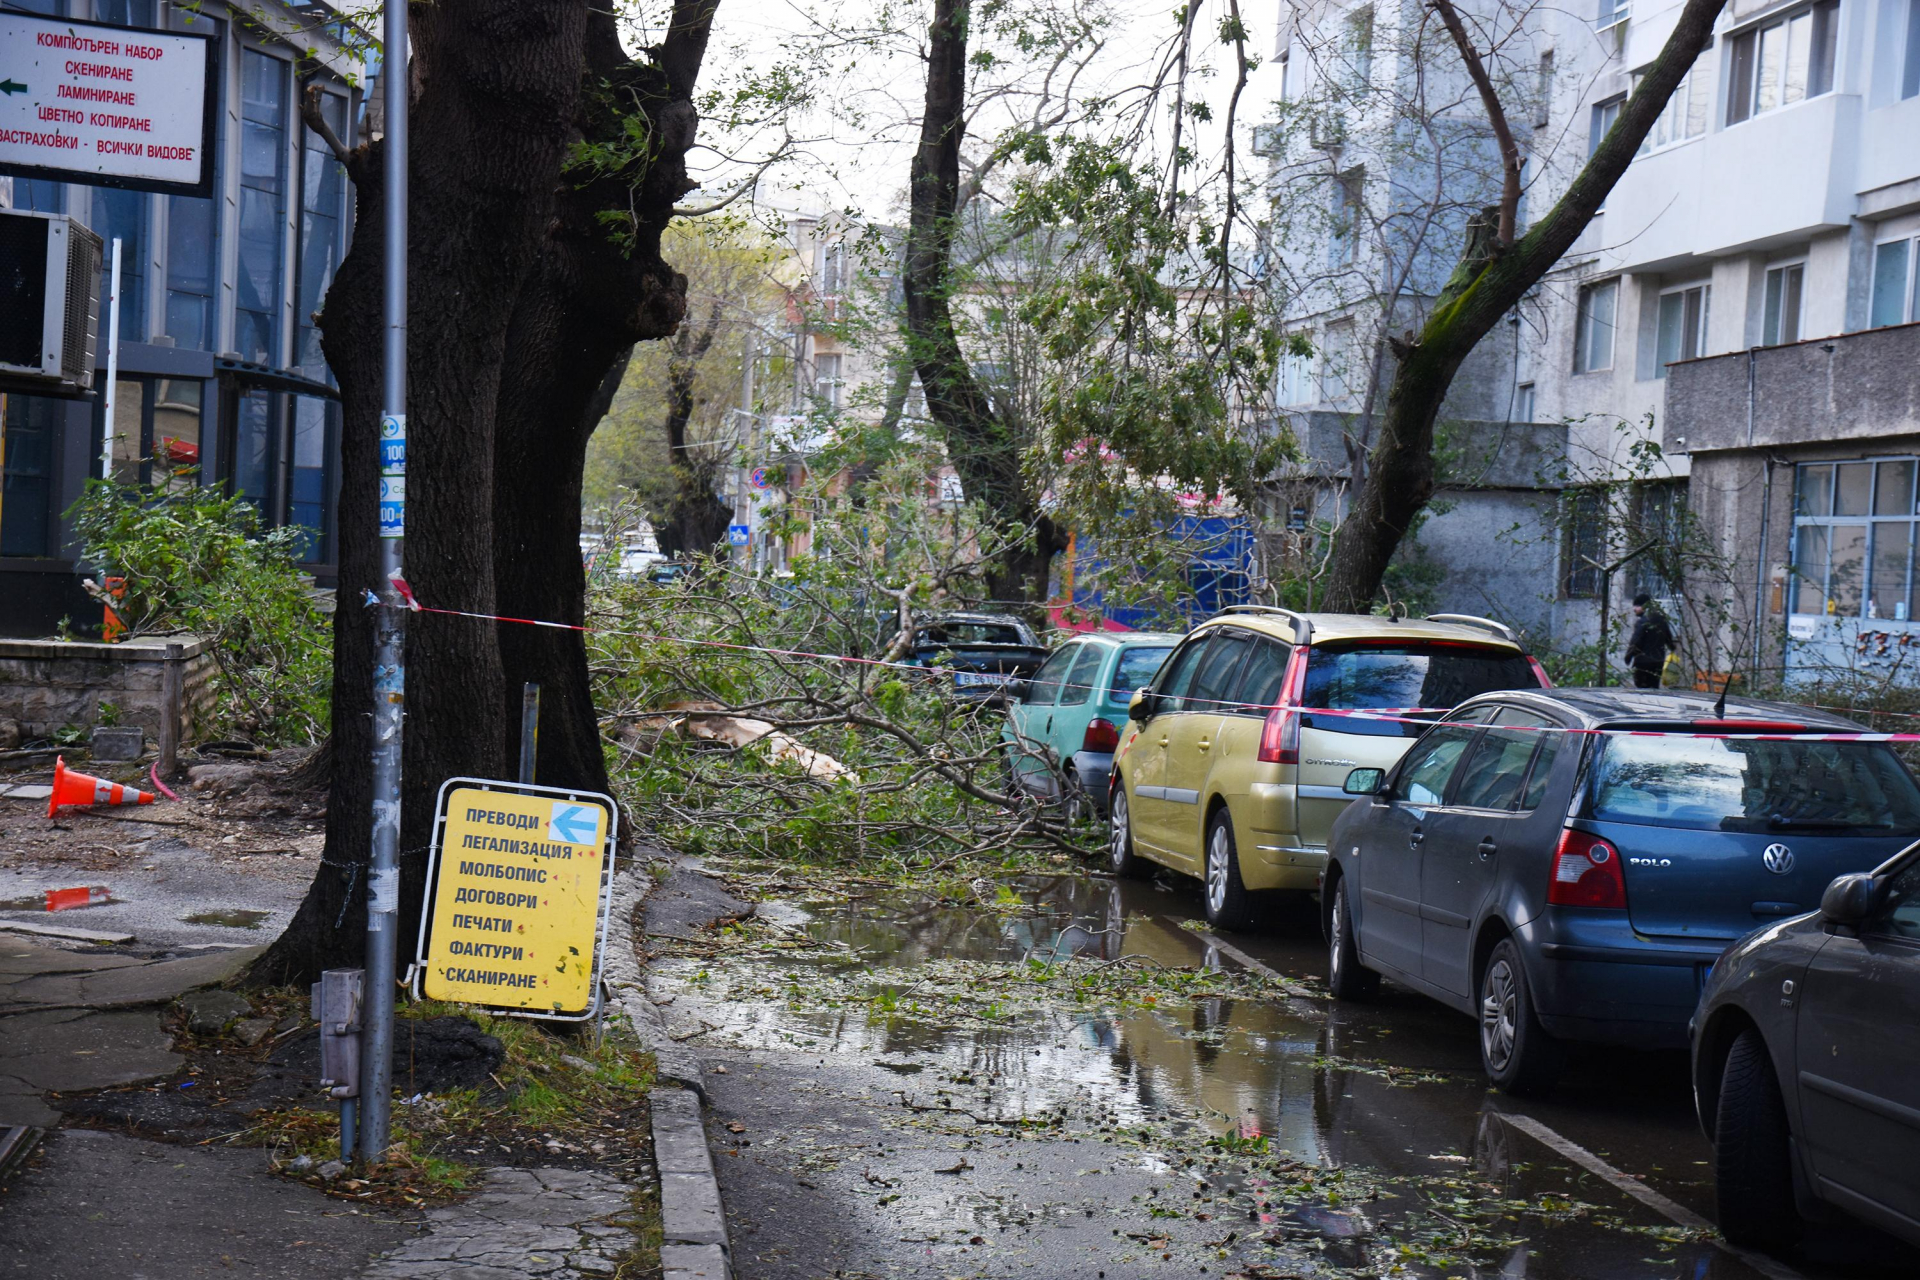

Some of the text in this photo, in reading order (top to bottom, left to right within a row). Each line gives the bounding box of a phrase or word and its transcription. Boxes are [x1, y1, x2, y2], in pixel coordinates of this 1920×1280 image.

[37, 32, 163, 61] КОМПЮТЪРЕН НАБОР
[65, 60, 133, 82] СКЕНИРАНЕ
[57, 85, 135, 106] ЛАМИНИРАНЕ
[38, 106, 151, 132] ЦВЕТНО КОПИРАНЕ
[97, 140, 143, 156] ВСИЧКИ
[147, 145, 193, 161] ВИДОВЕ
[466, 808, 539, 831] ПРЕВОДИ
[462, 834, 572, 860] ЛЕГАЛИЗАЦИЯ
[459, 861, 547, 884] МОЛБОПИС
[1630, 857, 1671, 867] POLO
[455, 887, 537, 909] ДОГОВОРИ
[453, 914, 512, 933] ПЕЧАТИ
[450, 940, 523, 961] ФАКТУРИ
[446, 967, 537, 989] СКАНИРАНЕ
